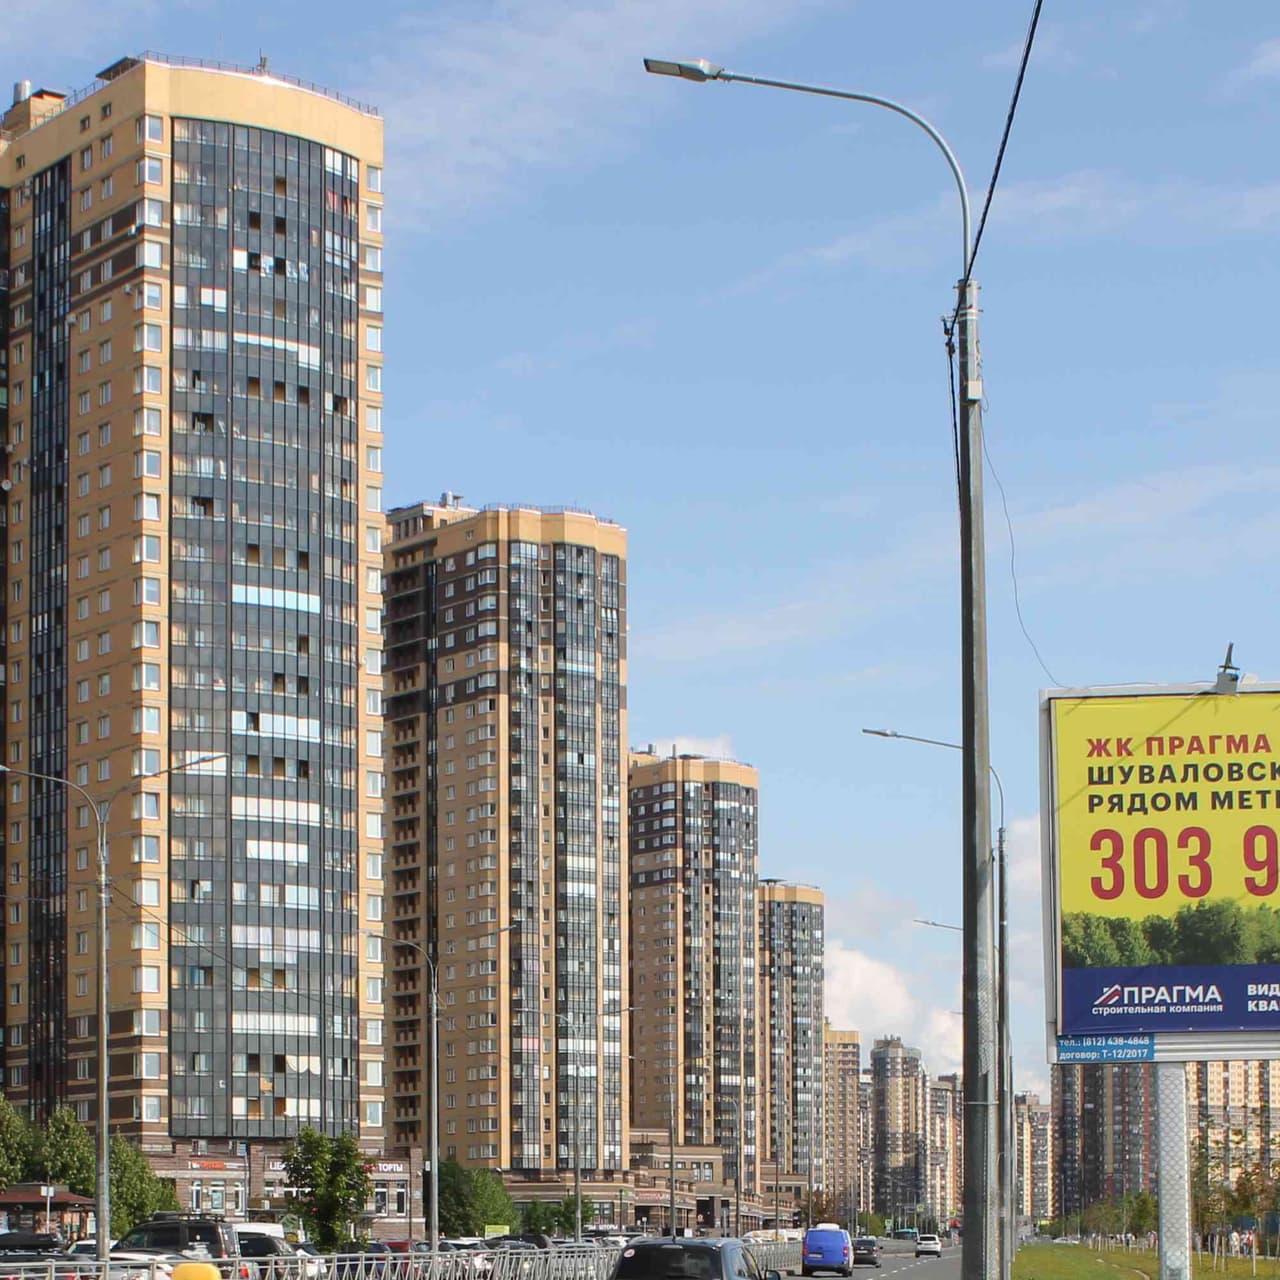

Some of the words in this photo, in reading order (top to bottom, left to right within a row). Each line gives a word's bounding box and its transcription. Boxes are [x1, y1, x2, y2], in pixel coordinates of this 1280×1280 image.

[1086, 737, 1134, 758] ЖК
[1145, 734, 1272, 756] ПРАГМА
[1087, 791, 1198, 816] РЯДОМ
[1089, 826, 1213, 900] 303
[1123, 985, 1222, 1004] ПРАГМА
[1092, 1005, 1167, 1016] строительная
[1169, 1004, 1224, 1014] компания
[1059, 1039, 1081, 1047] тел.:
[1083, 1036, 1106, 1047] (812)
[1059, 1051, 1100, 1060] договор:
[1102, 1048, 1149, 1059] Т-12/2017
[378, 1163, 403, 1172] ТОРТЫ
